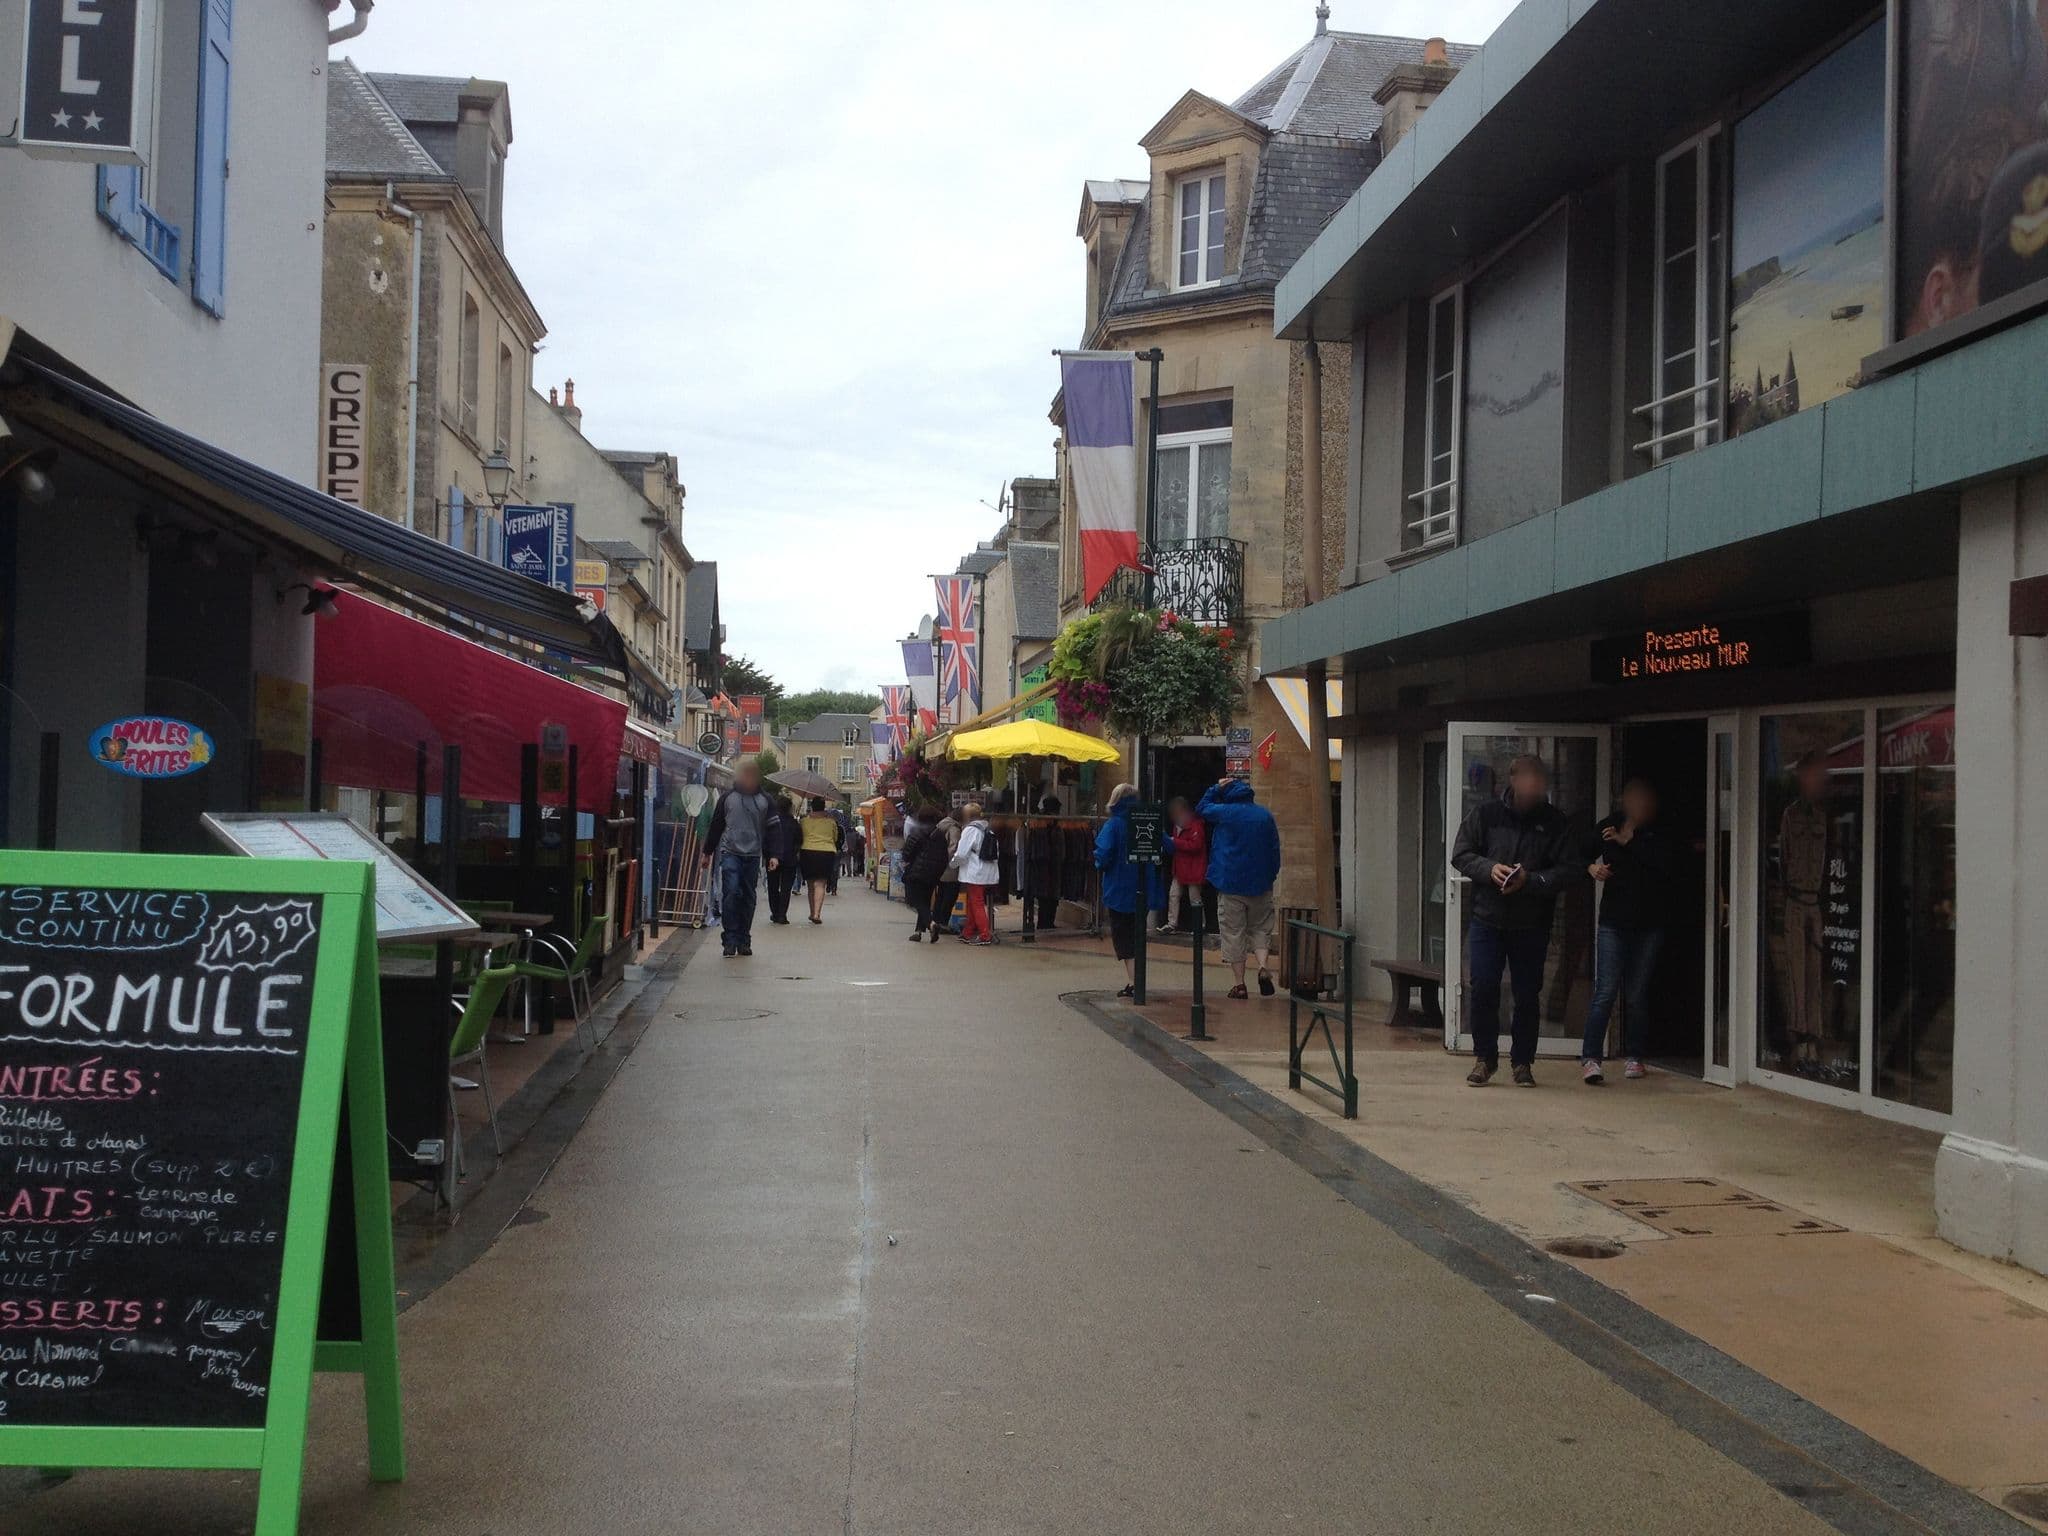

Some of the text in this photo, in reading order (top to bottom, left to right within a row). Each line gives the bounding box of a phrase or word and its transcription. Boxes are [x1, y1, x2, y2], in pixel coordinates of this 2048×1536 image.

[505, 510, 554, 536] VETEMENT
[1646, 625, 1720, 652] Presente
[1621, 641, 1750, 678] Le Nouveau MUR
[112, 719, 190, 747] MOULES
[123, 748, 192, 774] FRITES
[10, 887, 193, 918] SERVICE
[16, 915, 171, 942] CONTINU
[0, 965, 303, 1037] FORMULE
[15, 1156, 122, 1179] HUITRES
[0, 1187, 115, 1218] ATS:
[89, 1229, 183, 1246] SAUMON
